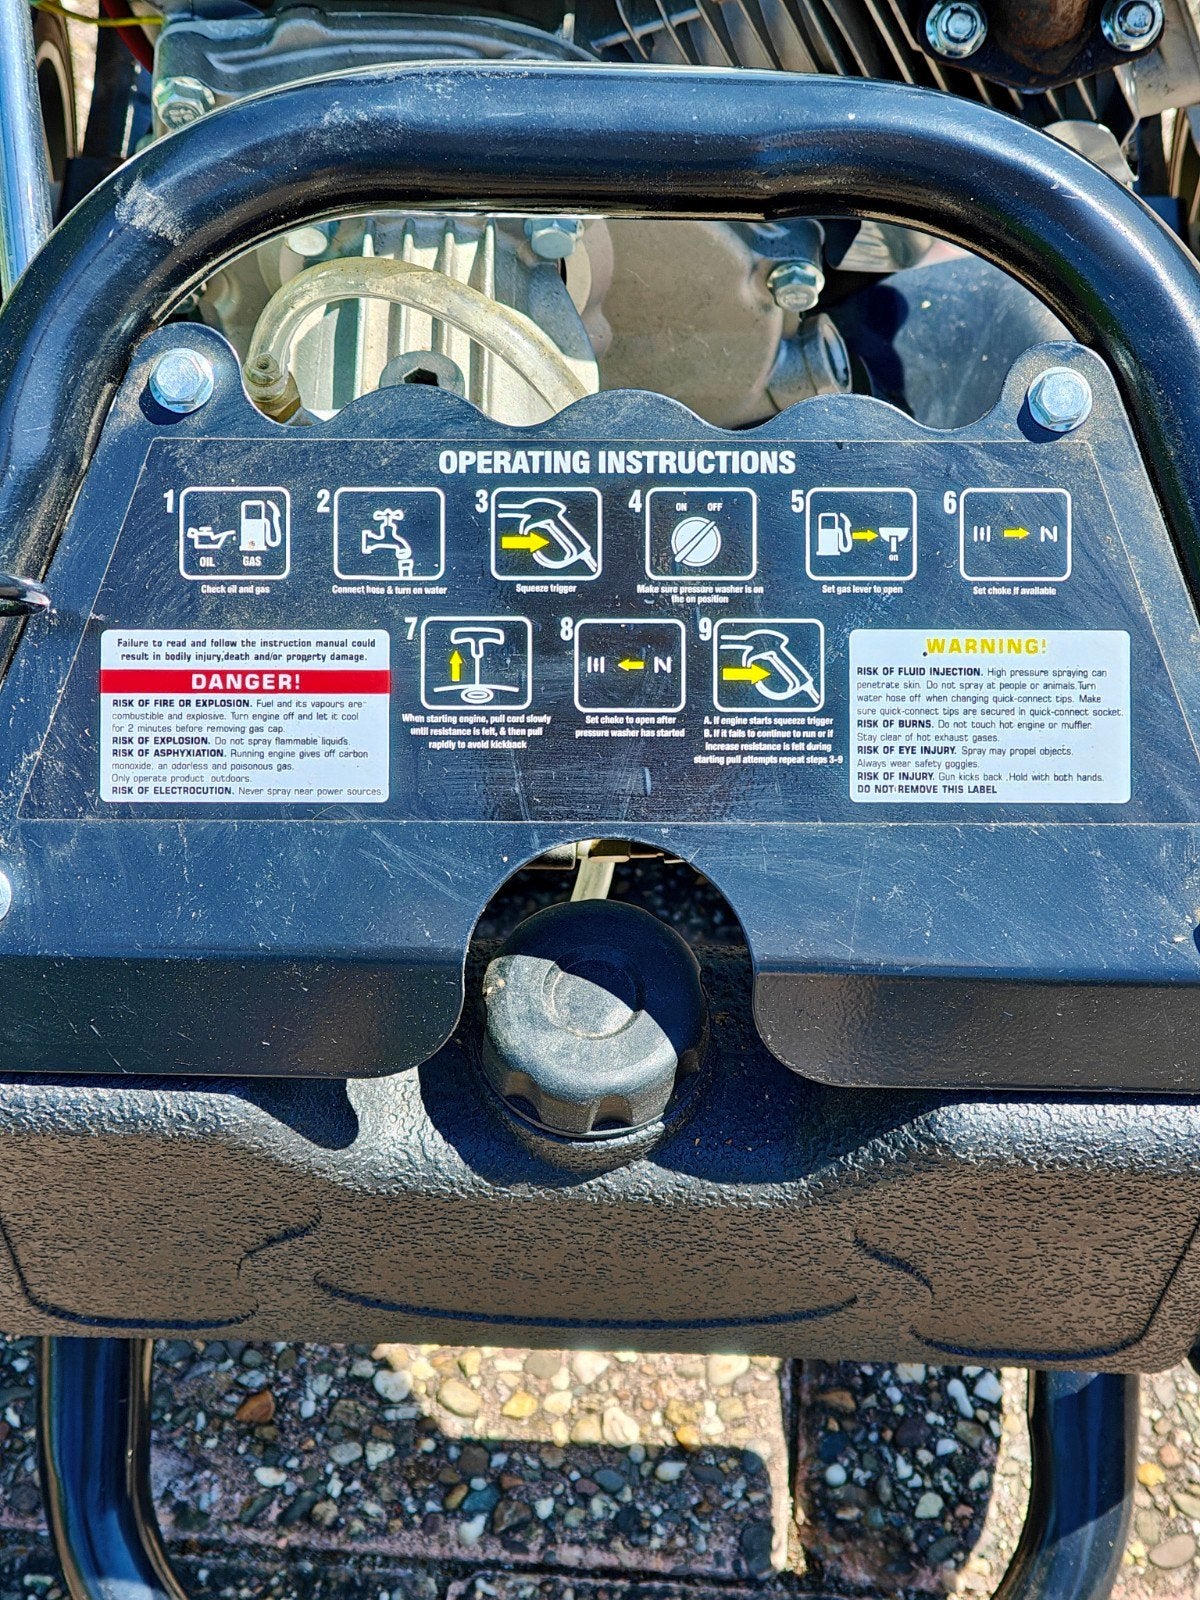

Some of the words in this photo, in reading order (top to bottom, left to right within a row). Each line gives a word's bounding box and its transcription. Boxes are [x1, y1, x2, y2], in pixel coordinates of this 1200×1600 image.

[439, 450, 590, 474] OPERATING
[598, 450, 796, 474] INSTRUCTIONS
[163, 489, 174, 513] 1
[317, 489, 330, 513] 2
[475, 489, 488, 513] 3
[628, 489, 641, 512] 4
[791, 490, 805, 513] 5
[943, 491, 957, 514] 6
[676, 502, 687, 511] ON
[707, 502, 723, 511] OFF
[199, 556, 216, 567] OIL
[242, 555, 262, 566] GAS
[201, 584, 226, 594] Check
[227, 585, 237, 594] oil
[238, 585, 254, 593] and
[255, 586, 270, 595] gas
[332, 585, 365, 595] Connect
[366, 585, 385, 594] hose
[386, 585, 393, 594] &
[395, 586, 411, 594] turn
[424, 586, 447, 594] water
[516, 584, 549, 594] Squeeze
[550, 584, 577, 594] trigger
[637, 585, 660, 593] Make
[679, 586, 714, 595] pressure
[715, 585, 744, 593] washer
[745, 585, 752, 593] is
[753, 586, 764, 594] on
[822, 585, 835, 594] Set
[836, 587, 851, 595] gas
[852, 585, 872, 593] lever
[883, 586, 903, 595] open
[973, 586, 986, 595] Set
[987, 586, 1012, 595] choke
[1020, 586, 1057, 595] available
[671, 595, 685, 604] the
[697, 595, 729, 604] position
[405, 618, 418, 639] 7
[560, 617, 575, 641] 8
[699, 618, 712, 640] 9
[117, 638, 148, 647] Failure
[166, 638, 186, 647] read
[191, 638, 207, 647] and
[211, 638, 237, 647] follow
[241, 638, 256, 647] the
[260, 638, 312, 647] instruction
[316, 638, 348, 647] manual
[351, 638, 375, 647] could
[927, 639, 1046, 654] WARNING!
[121, 652, 149, 660] result
[153, 652, 161, 660] in
[165, 652, 191, 663] bodily
[195, 652, 250, 663] injury,death
[254, 652, 283, 661] and/or
[286, 653, 326, 663] property
[330, 652, 367, 663] damage.
[857, 667, 879, 675] RISK
[882, 667, 894, 676] OF
[898, 667, 926, 676] FLUID
[929, 667, 983, 676] INJECTION.
[988, 668, 1006, 678] High
[1010, 670, 1049, 678] pressure
[1052, 670, 1088, 678] spraying
[192, 674, 299, 690] DANGER!
[113, 699, 134, 707] RISK
[138, 699, 150, 707] OF
[154, 699, 174, 707] FIRE
[179, 699, 191, 707] OR
[195, 699, 252, 707] EXPLOSION.
[257, 699, 273, 707] Fuel
[402, 713, 425, 723] When
[426, 714, 457, 724] starting
[459, 714, 489, 724] engine,
[490, 714, 505, 724] pull
[506, 714, 525, 723] cord
[526, 714, 551, 724] slowly
[585, 715, 599, 724] Set
[600, 715, 624, 724] choke
[625, 715, 634, 724] to
[635, 717, 655, 726] open
[656, 715, 677, 724] after
[721, 716, 748, 726] engine
[749, 716, 773, 725] starts
[773, 718, 806, 726] squeeze
[807, 716, 833, 726] trigger
[857, 719, 878, 728] RISK
[882, 719, 894, 728] OF
[898, 719, 934, 728] BURNS.
[938, 719, 950, 728] Do
[971, 720, 995, 729] touch
[999, 720, 1013, 729] hot
[1017, 722, 1045, 730] engine
[1062, 720, 1093, 729] muffler.
[410, 727, 429, 735] until
[430, 727, 472, 736] resistance
[473, 727, 481, 735] is
[499, 726, 506, 736] &
[507, 727, 526, 736] then
[527, 727, 543, 737] pull
[575, 730, 609, 739] pressure
[610, 728, 640, 737] washer
[640, 728, 655, 737] has
[656, 728, 685, 737] started
[728, 729, 746, 738] fails
[747, 729, 756, 738] to
[756, 729, 791, 738] continue
[792, 730, 801, 738] to
[429, 740, 456, 750] rapidly
[457, 740, 466, 749] to
[467, 740, 489, 749] avoid
[490, 740, 527, 749] kickback
[112, 749, 134, 757] RISK
[138, 749, 149, 757] OF
[153, 749, 226, 757] ASPHYXIATION.
[231, 749, 264, 759] Running
[268, 751, 295, 759] engine
[299, 751, 320, 759] gives
[324, 749, 336, 757] off
[339, 750, 368, 758] carbon
[858, 785, 870, 793] DO
[875, 785, 894, 793] NOT
[898, 785, 938, 793] REMOVE
[942, 785, 964, 794] THIS
[968, 785, 997, 794] LABEL
